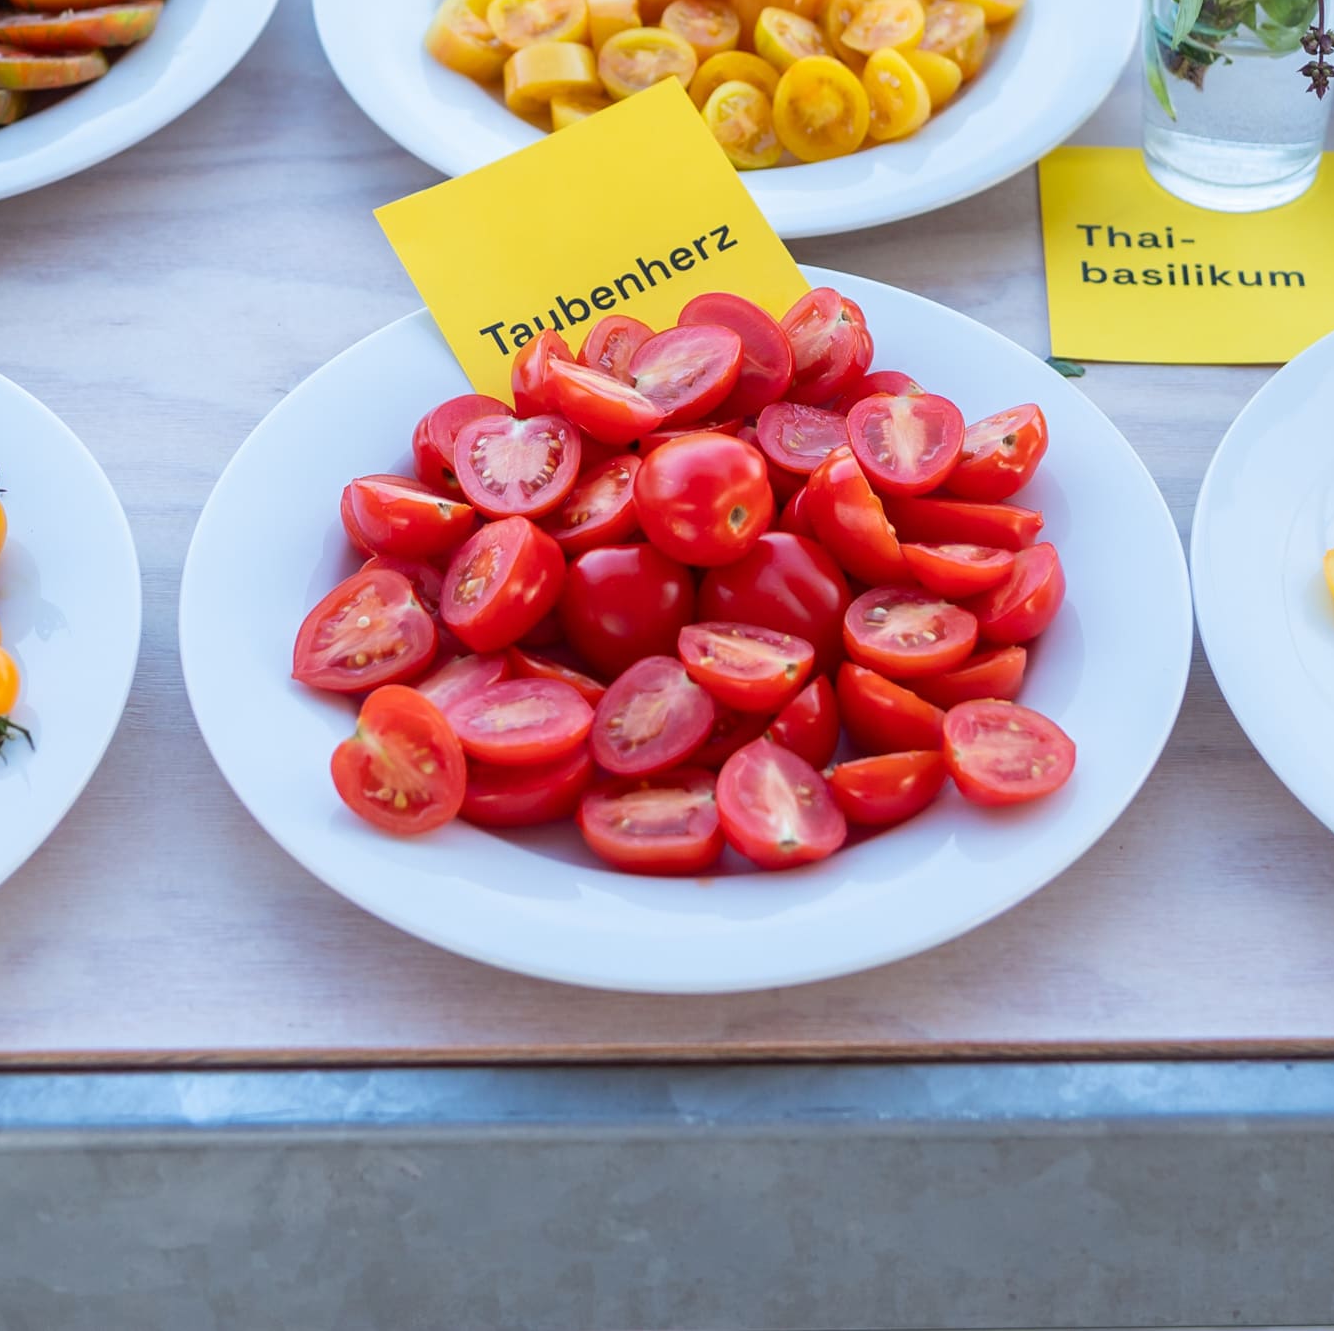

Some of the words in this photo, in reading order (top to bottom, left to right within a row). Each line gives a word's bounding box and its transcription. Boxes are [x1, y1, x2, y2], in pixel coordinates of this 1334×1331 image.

[1075, 224, 1196, 249] Thai-
[1080, 261, 1308, 288] basilikum
[479, 224, 738, 357] Taubenherz
